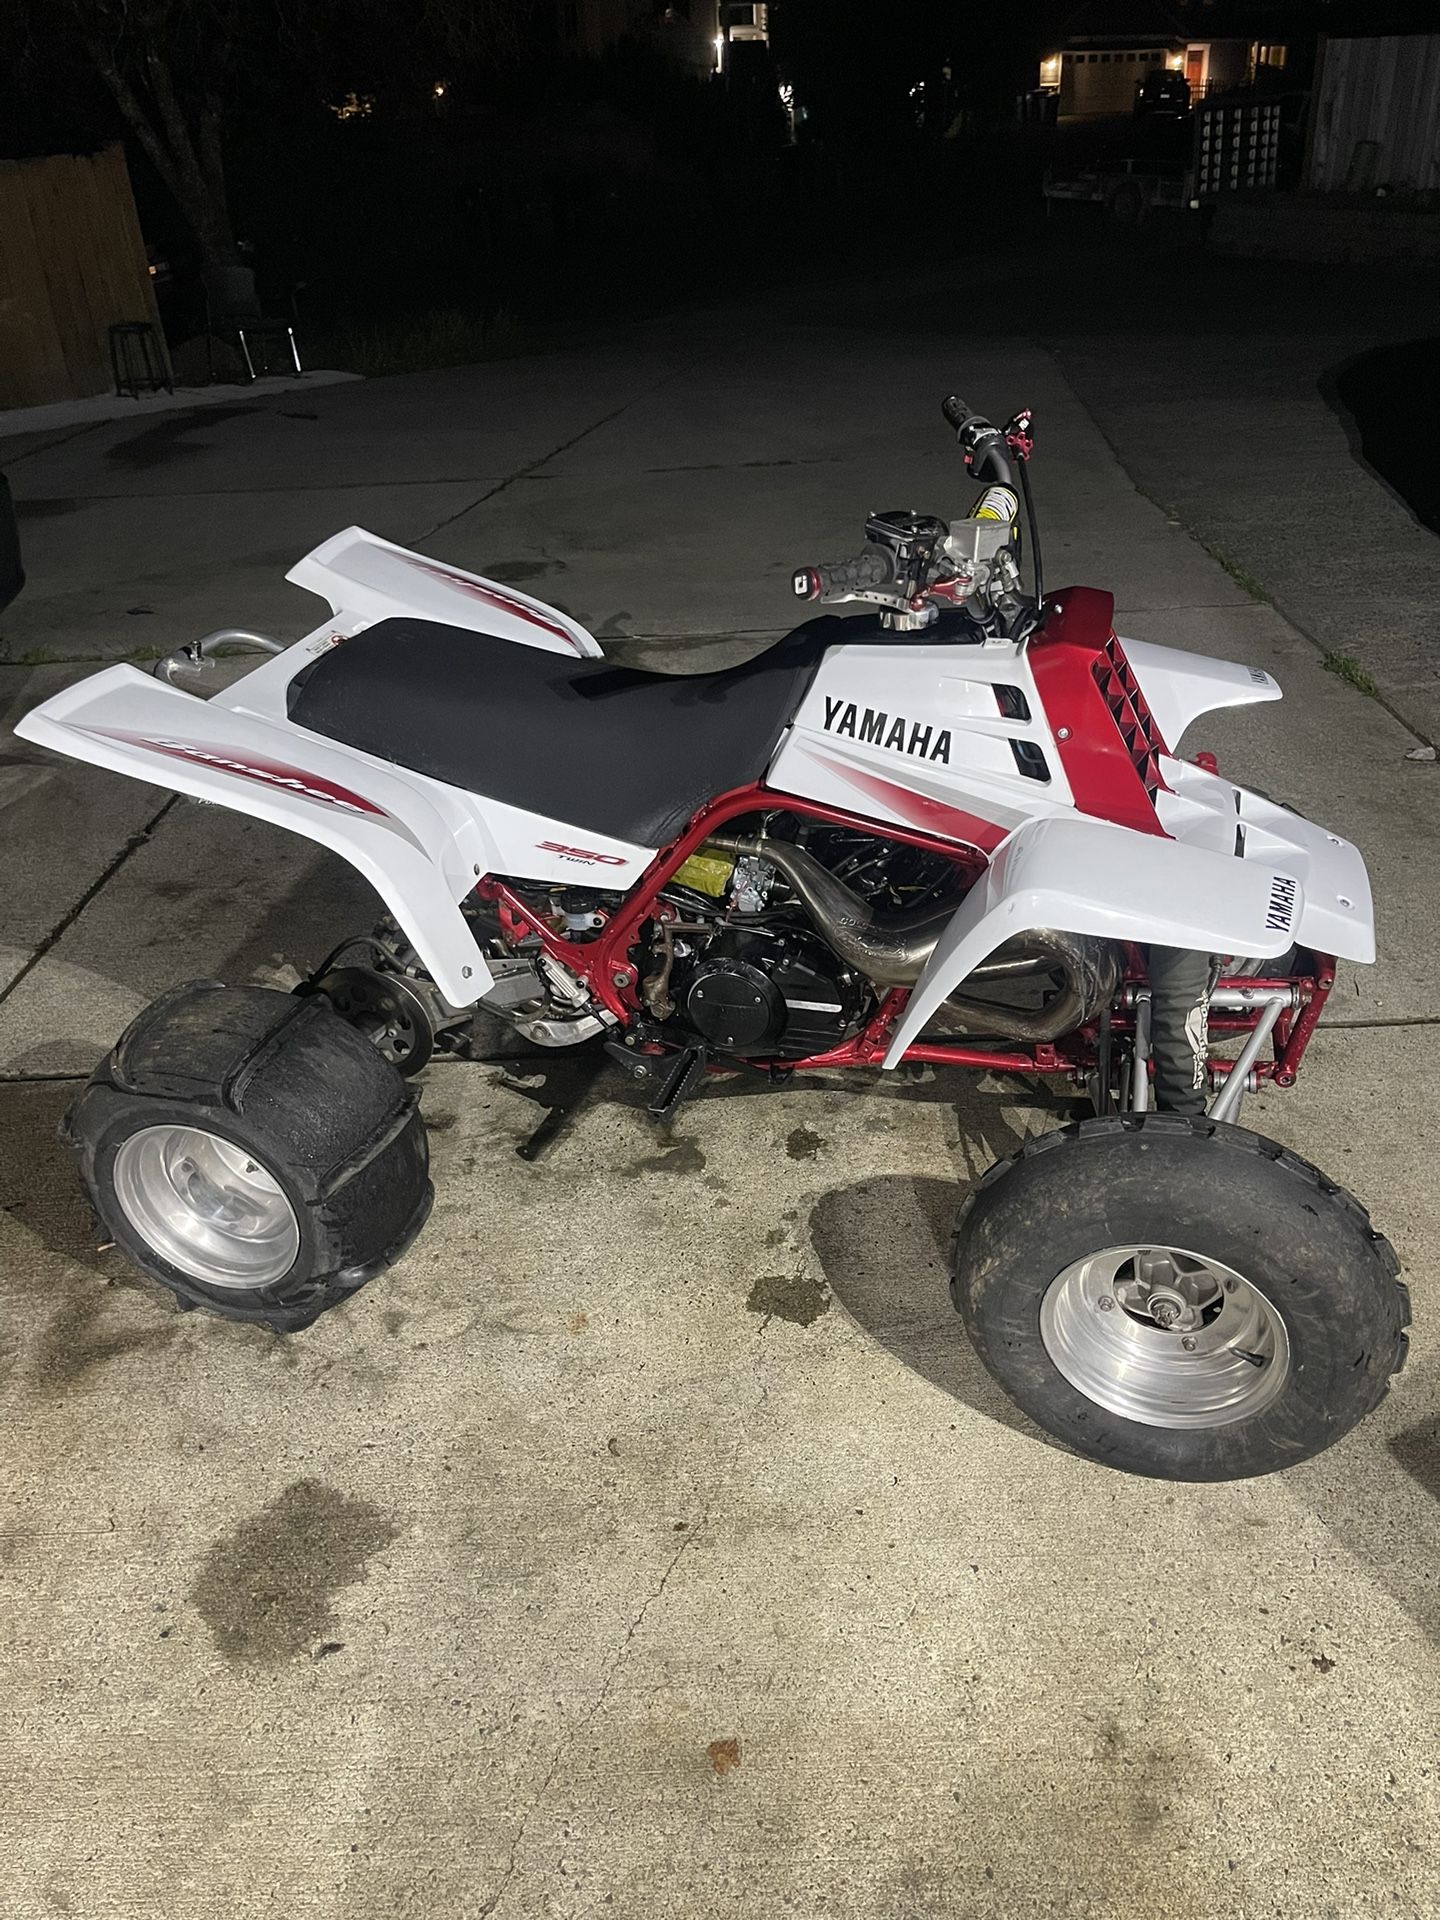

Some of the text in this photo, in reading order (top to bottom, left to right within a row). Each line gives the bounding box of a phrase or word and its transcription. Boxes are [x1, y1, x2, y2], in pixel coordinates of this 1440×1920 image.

[823, 695, 952, 765] YAMAHA
[140, 737, 365, 814] Banshee
[534, 840, 629, 866] 350
[558, 854, 596, 866] TWIN
[1265, 876, 1296, 932] YAMAHA
